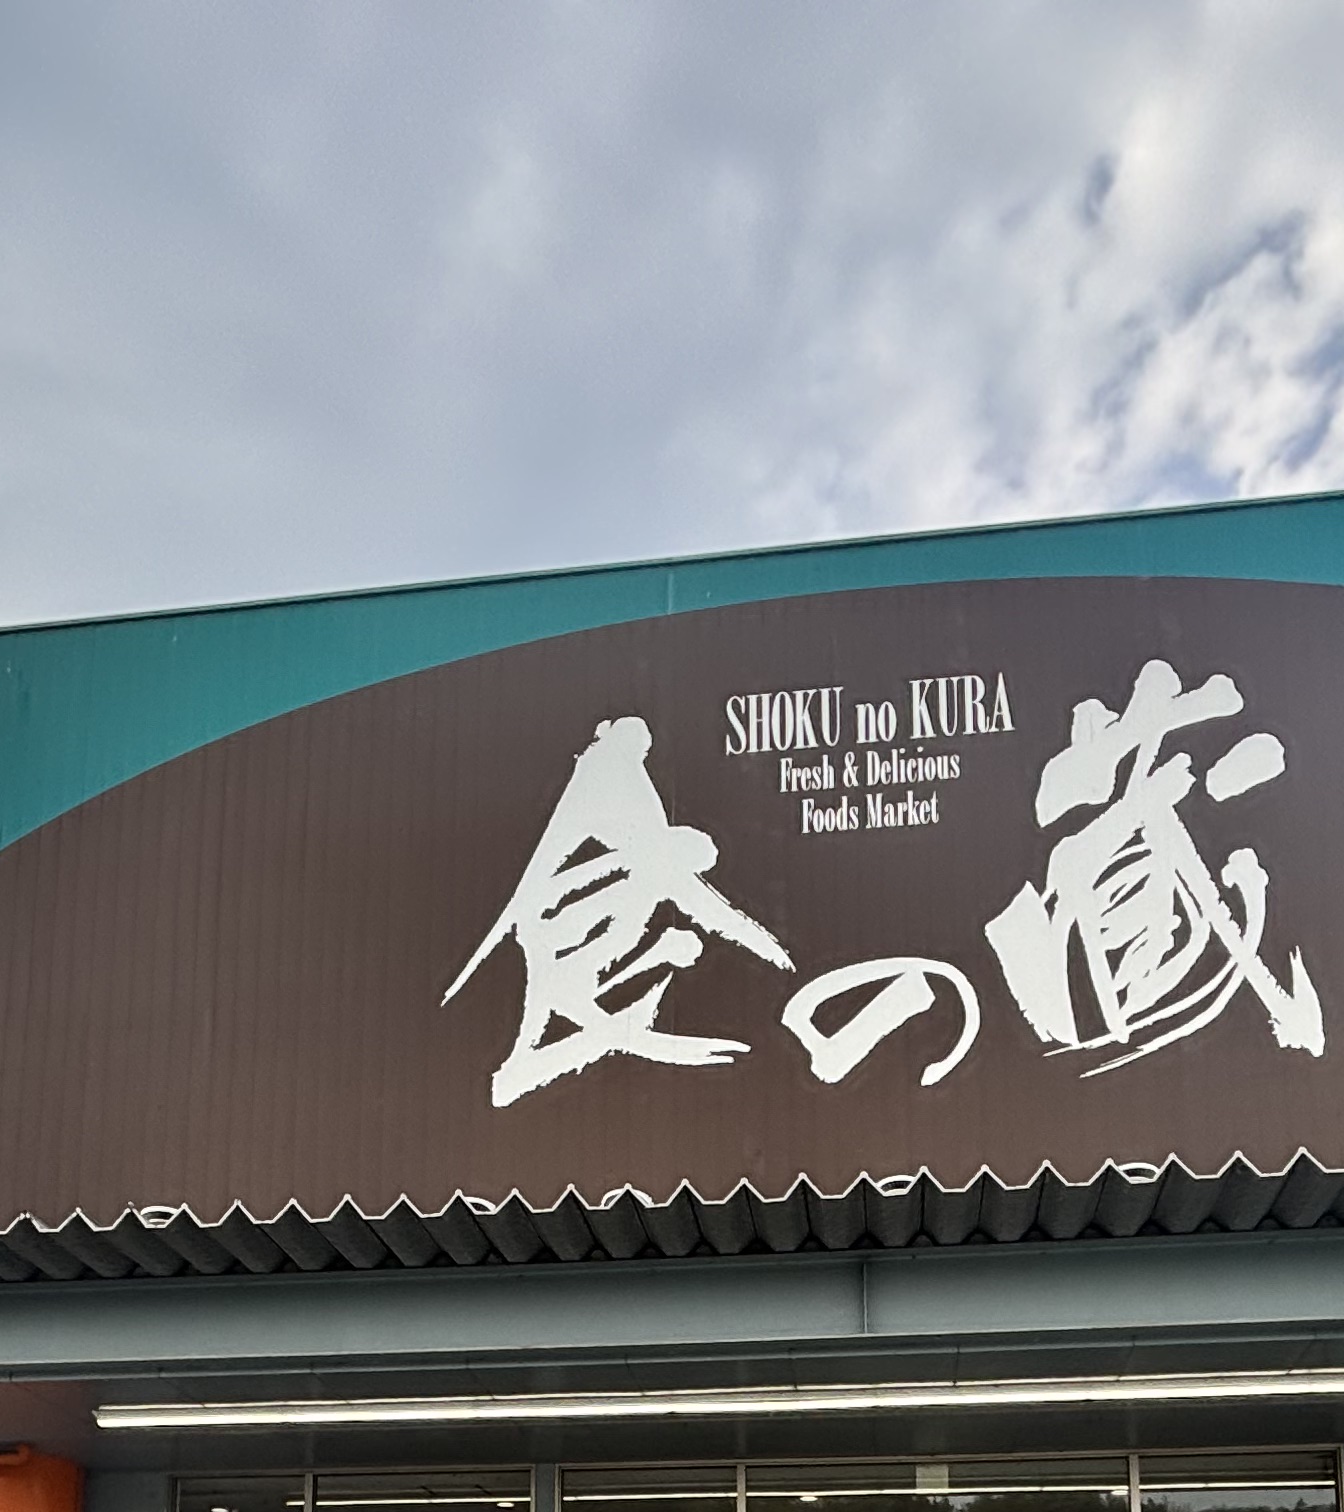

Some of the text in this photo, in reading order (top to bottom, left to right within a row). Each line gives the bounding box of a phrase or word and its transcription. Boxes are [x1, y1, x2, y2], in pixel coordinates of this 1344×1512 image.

[725, 673, 1015, 755] SHOKU no KURA
[779, 748, 961, 793] Fresh & Delicious
[800, 793, 940, 835] Foods Market
[440, 659, 1325, 1108] 食の蔵
